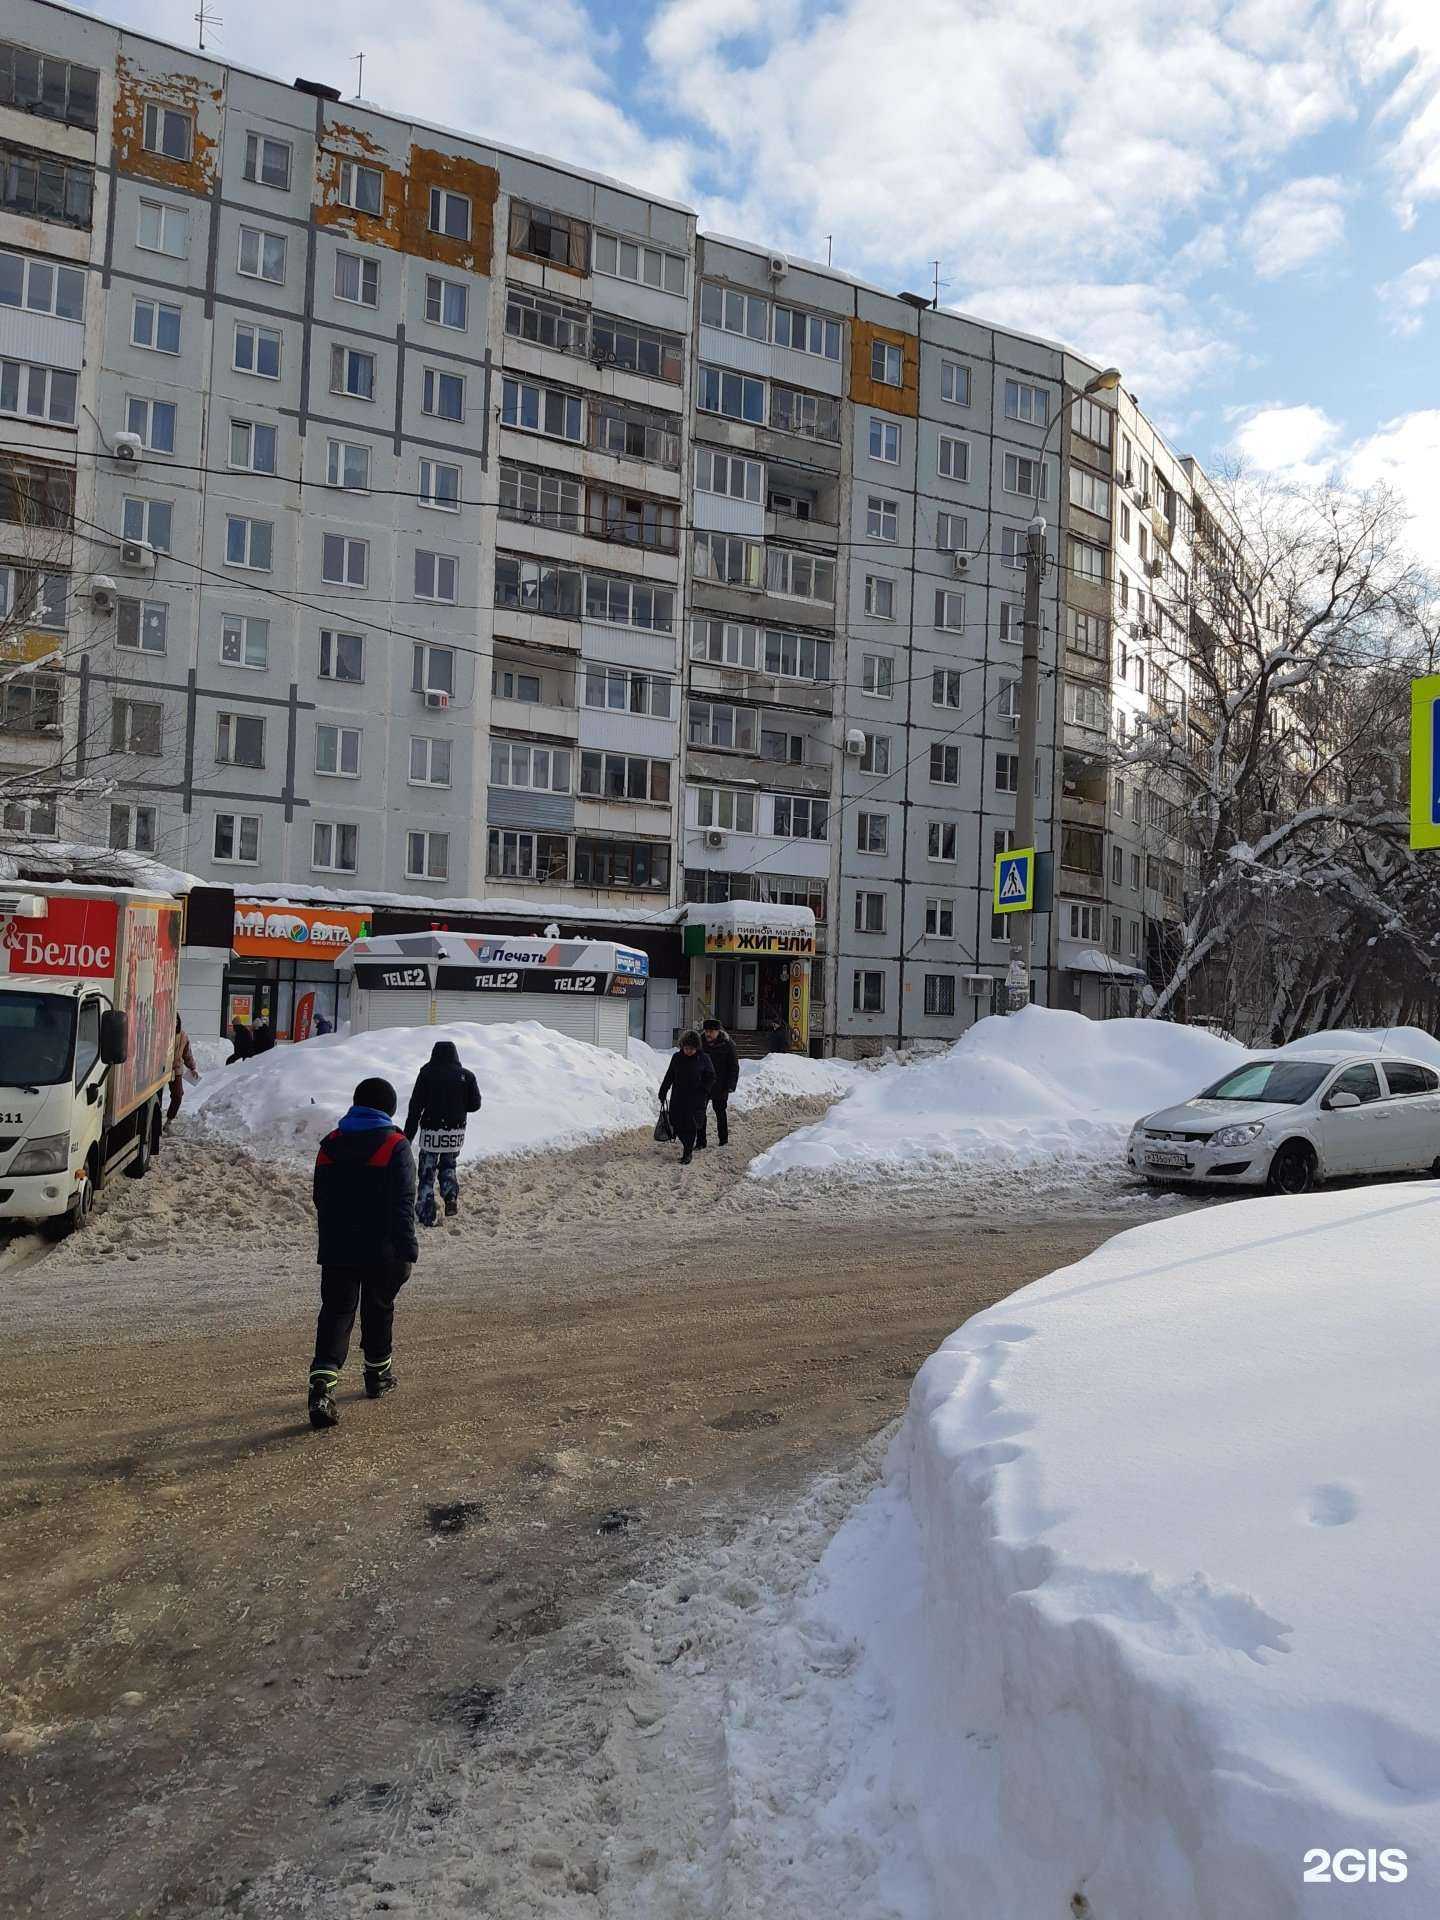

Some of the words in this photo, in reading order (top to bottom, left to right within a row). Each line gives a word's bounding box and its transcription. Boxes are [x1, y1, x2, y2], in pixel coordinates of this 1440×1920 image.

[233, 922, 288, 938] ПТЕКА
[310, 925, 352, 942] ВИТА
[737, 926, 773, 935] пивной
[775, 928, 813, 937] магазин
[737, 934, 812, 952] ЖИГУЛИ
[492, 949, 547, 963] Печать
[382, 968, 426, 986] TELE2
[475, 972, 519, 988] TELE2
[554, 976, 597, 992] TELE2
